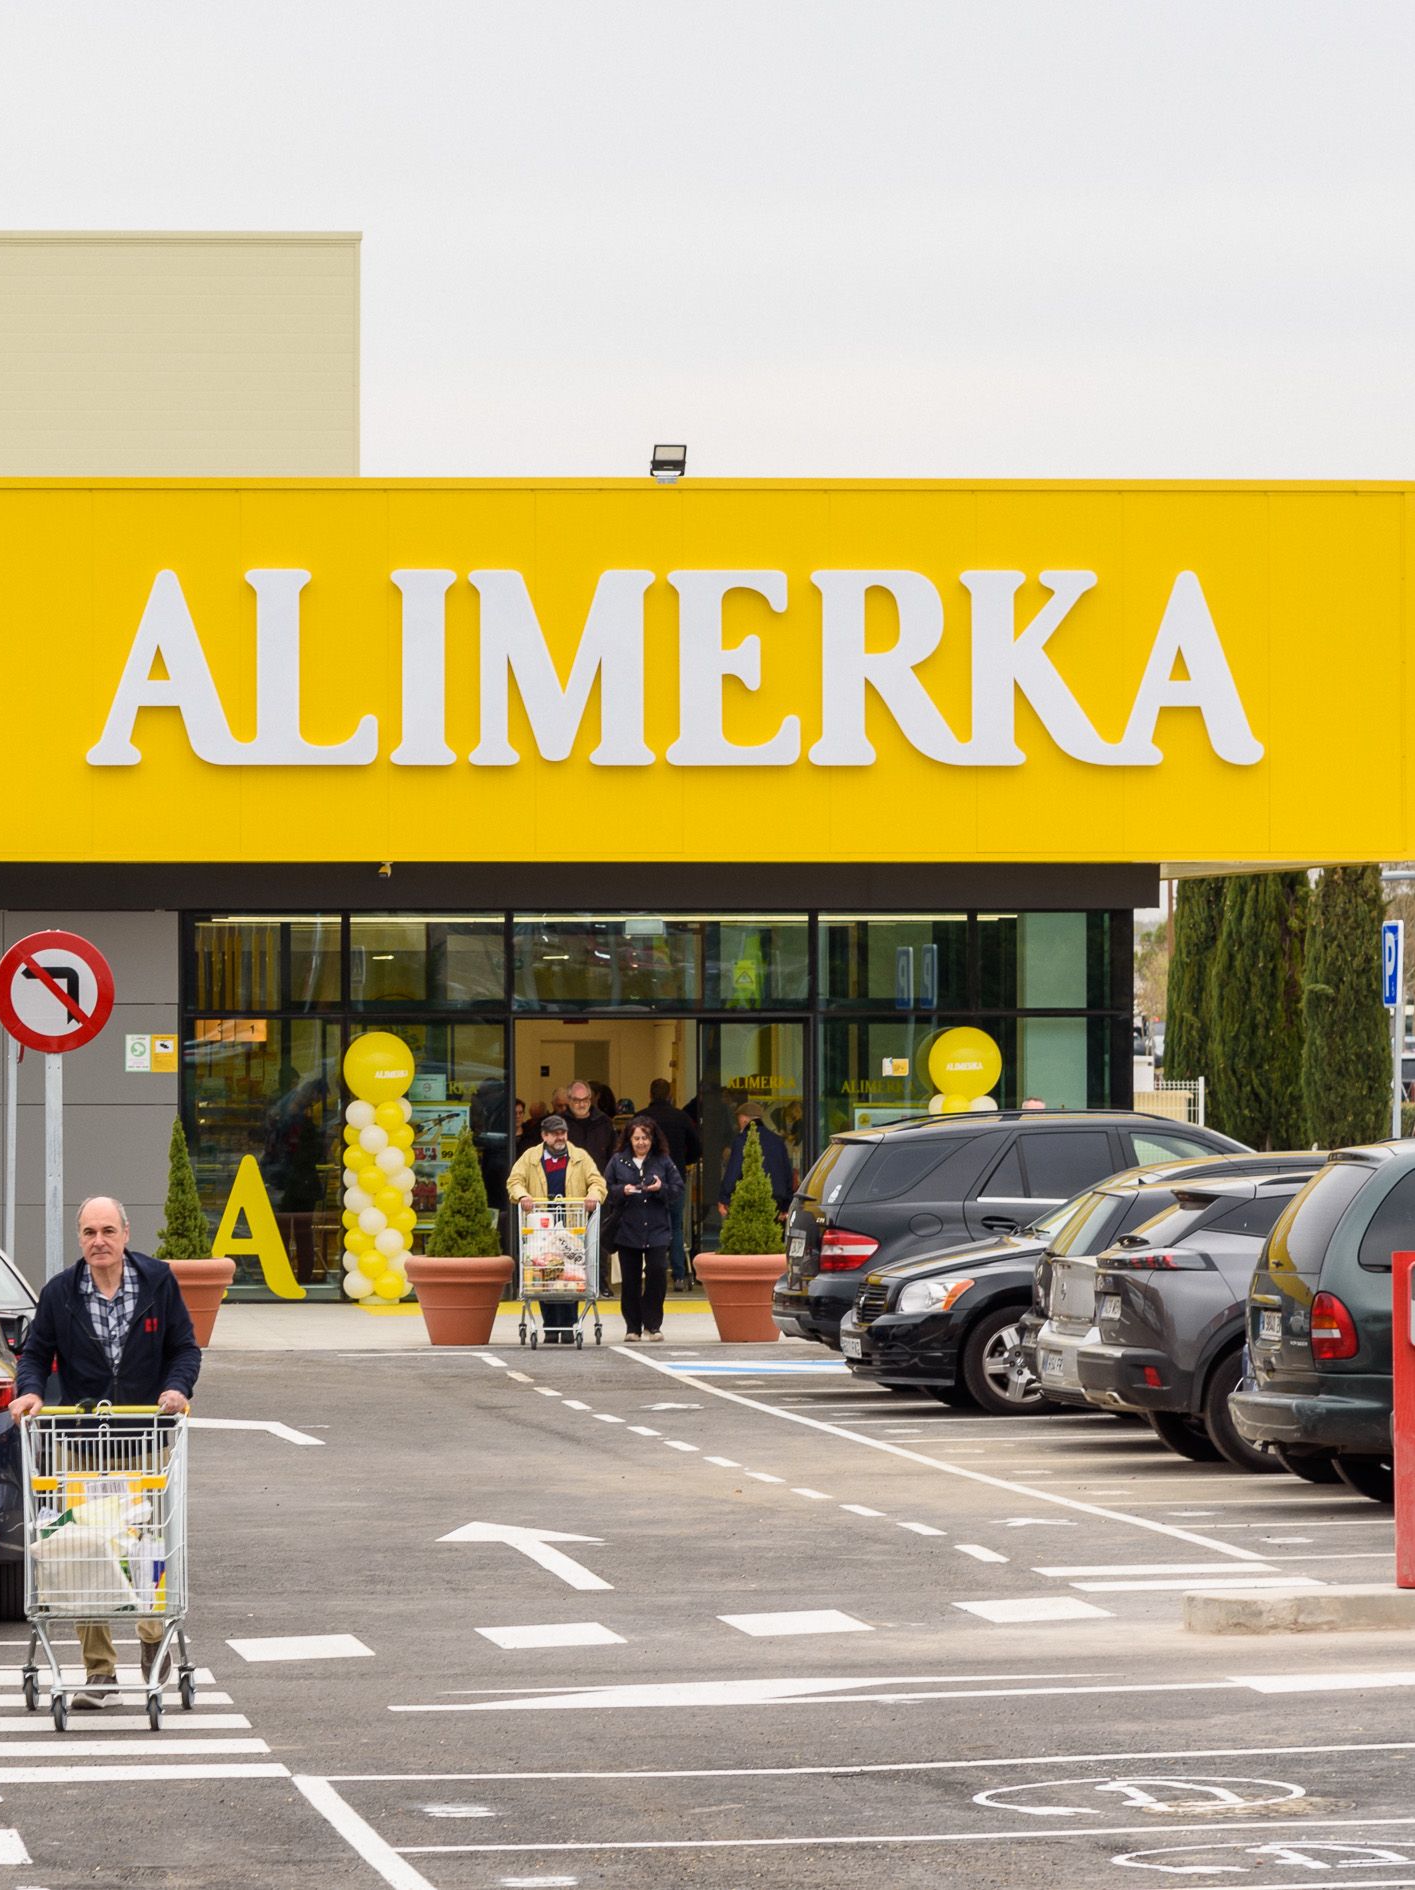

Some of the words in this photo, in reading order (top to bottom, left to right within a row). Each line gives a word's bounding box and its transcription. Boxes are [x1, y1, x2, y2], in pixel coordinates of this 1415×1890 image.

[86, 569, 1264, 765] ALIMERKA
[1386, 932, 1395, 997] P
[212, 1154, 307, 1299] A
